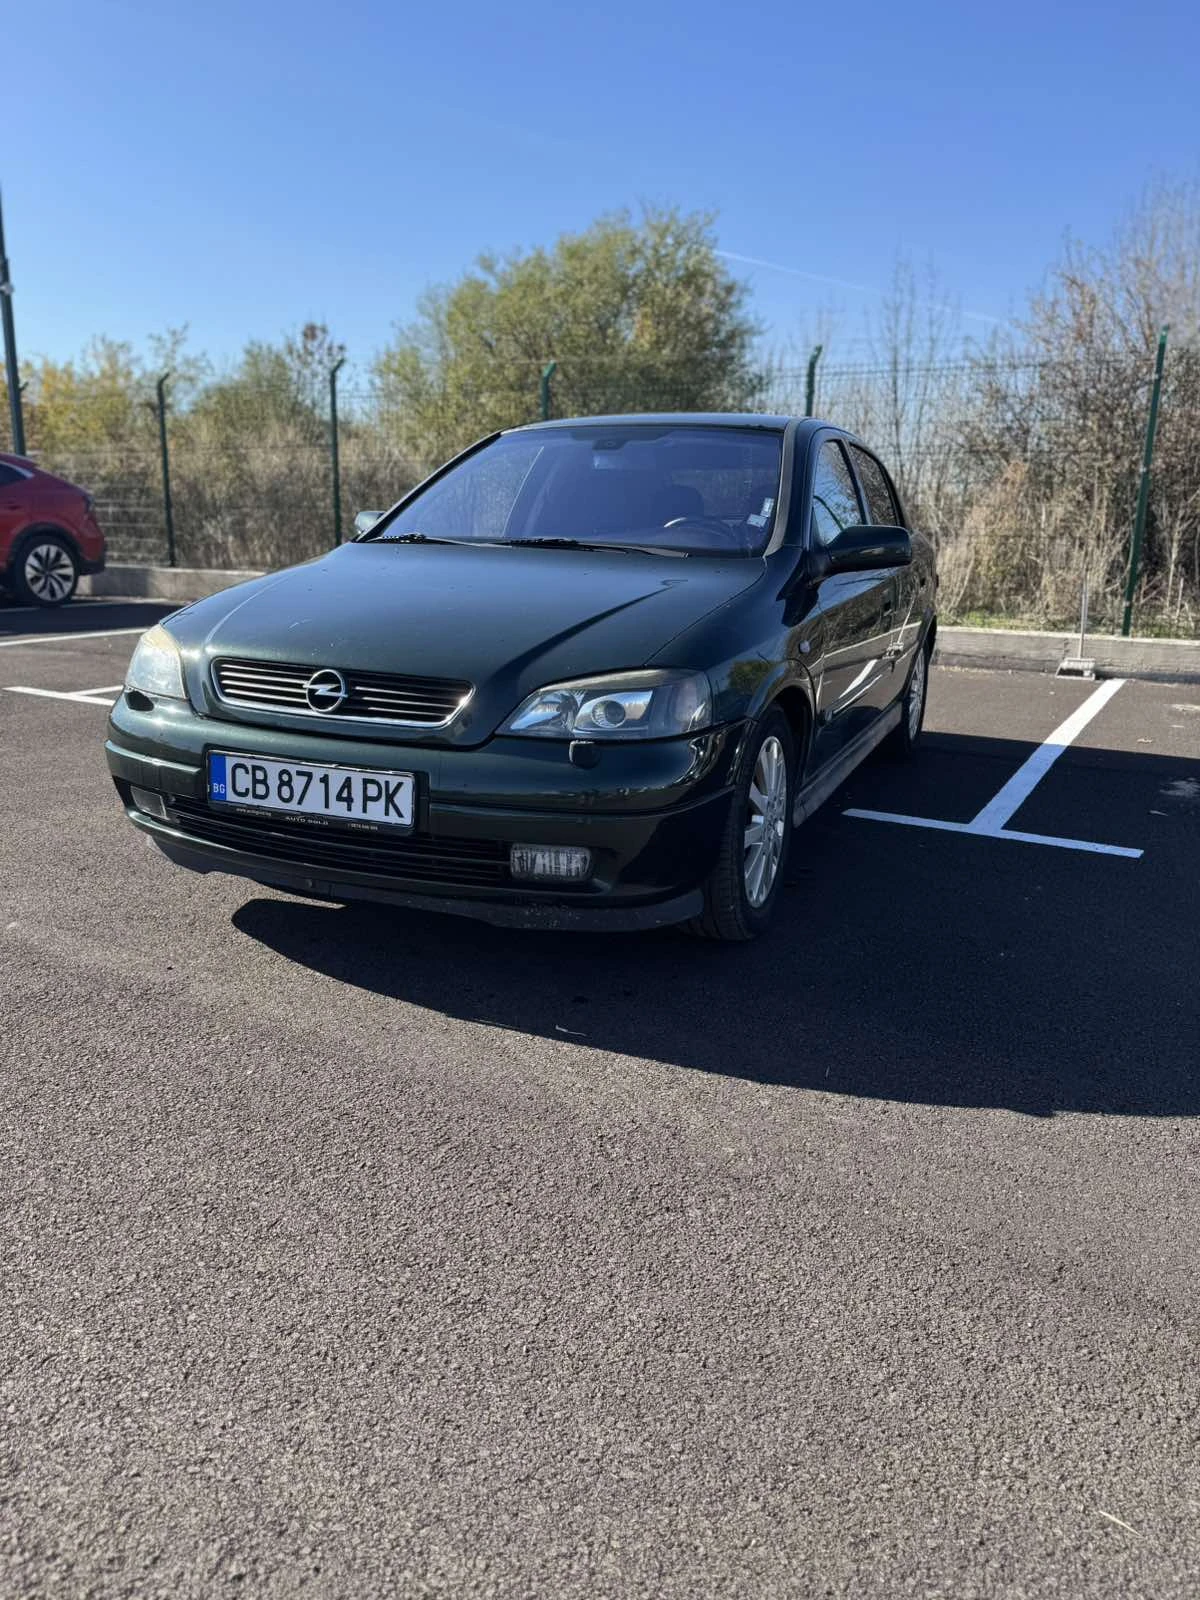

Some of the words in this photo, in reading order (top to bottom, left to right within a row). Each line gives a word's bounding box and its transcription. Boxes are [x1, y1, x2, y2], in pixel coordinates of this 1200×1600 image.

[213, 783, 225, 794] BG
[231, 763, 270, 800] CB
[277, 768, 354, 812] 8714
[362, 778, 404, 818] PK
